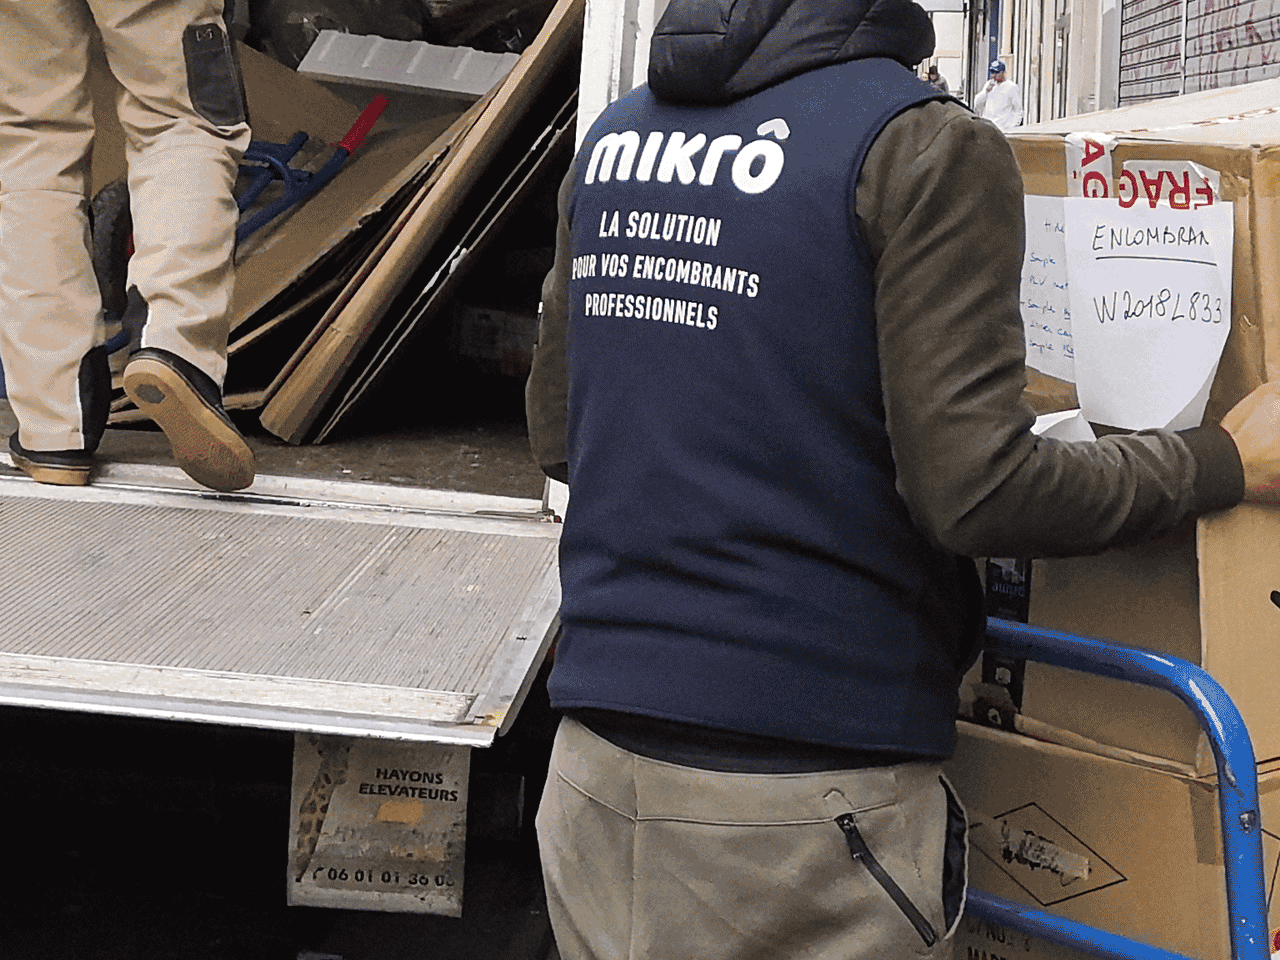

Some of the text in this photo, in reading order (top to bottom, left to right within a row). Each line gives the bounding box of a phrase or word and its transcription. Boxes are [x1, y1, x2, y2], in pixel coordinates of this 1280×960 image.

[598, 210, 722, 247] LA SOLUTION
[571, 253, 760, 298] POUR VOS ENCOMBRANTS
[584, 293, 719, 331] PROFESSIONNELS
[375, 768, 444, 785] HAYONS
[358, 782, 459, 802] ELEVATEURS
[327, 867, 349, 882] 06
[354, 868, 373, 883] 01
[381, 870, 400, 884] 01
